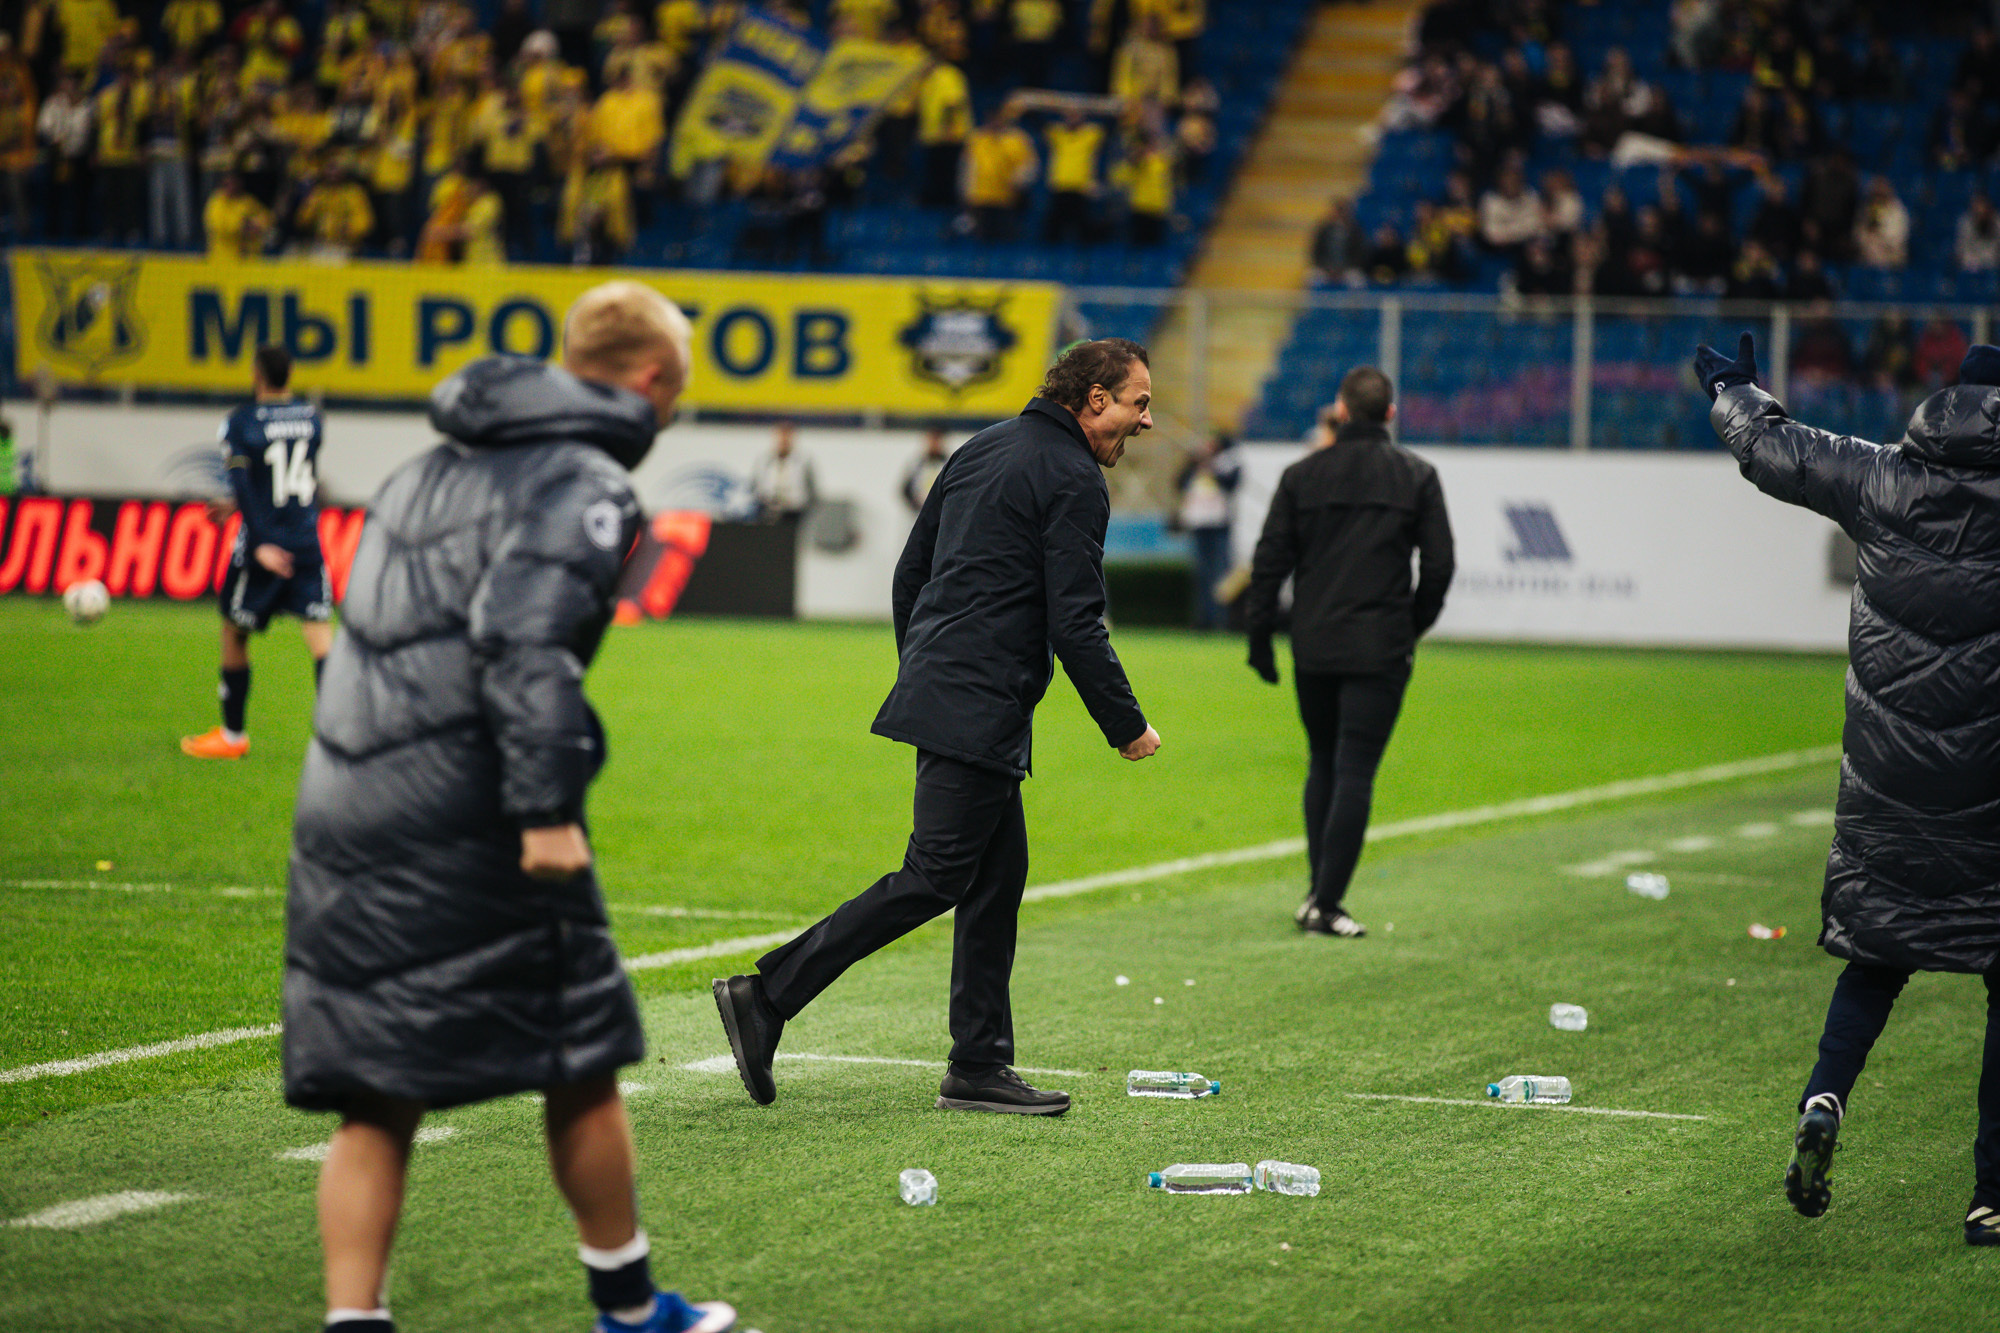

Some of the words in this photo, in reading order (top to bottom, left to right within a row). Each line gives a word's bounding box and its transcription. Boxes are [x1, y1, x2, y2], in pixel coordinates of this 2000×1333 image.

[190, 290, 370, 364] МЫ
[418, 298, 850, 379] РООВ
[264, 439, 316, 507] 14
[0, 496, 243, 600] ЛЬНО
